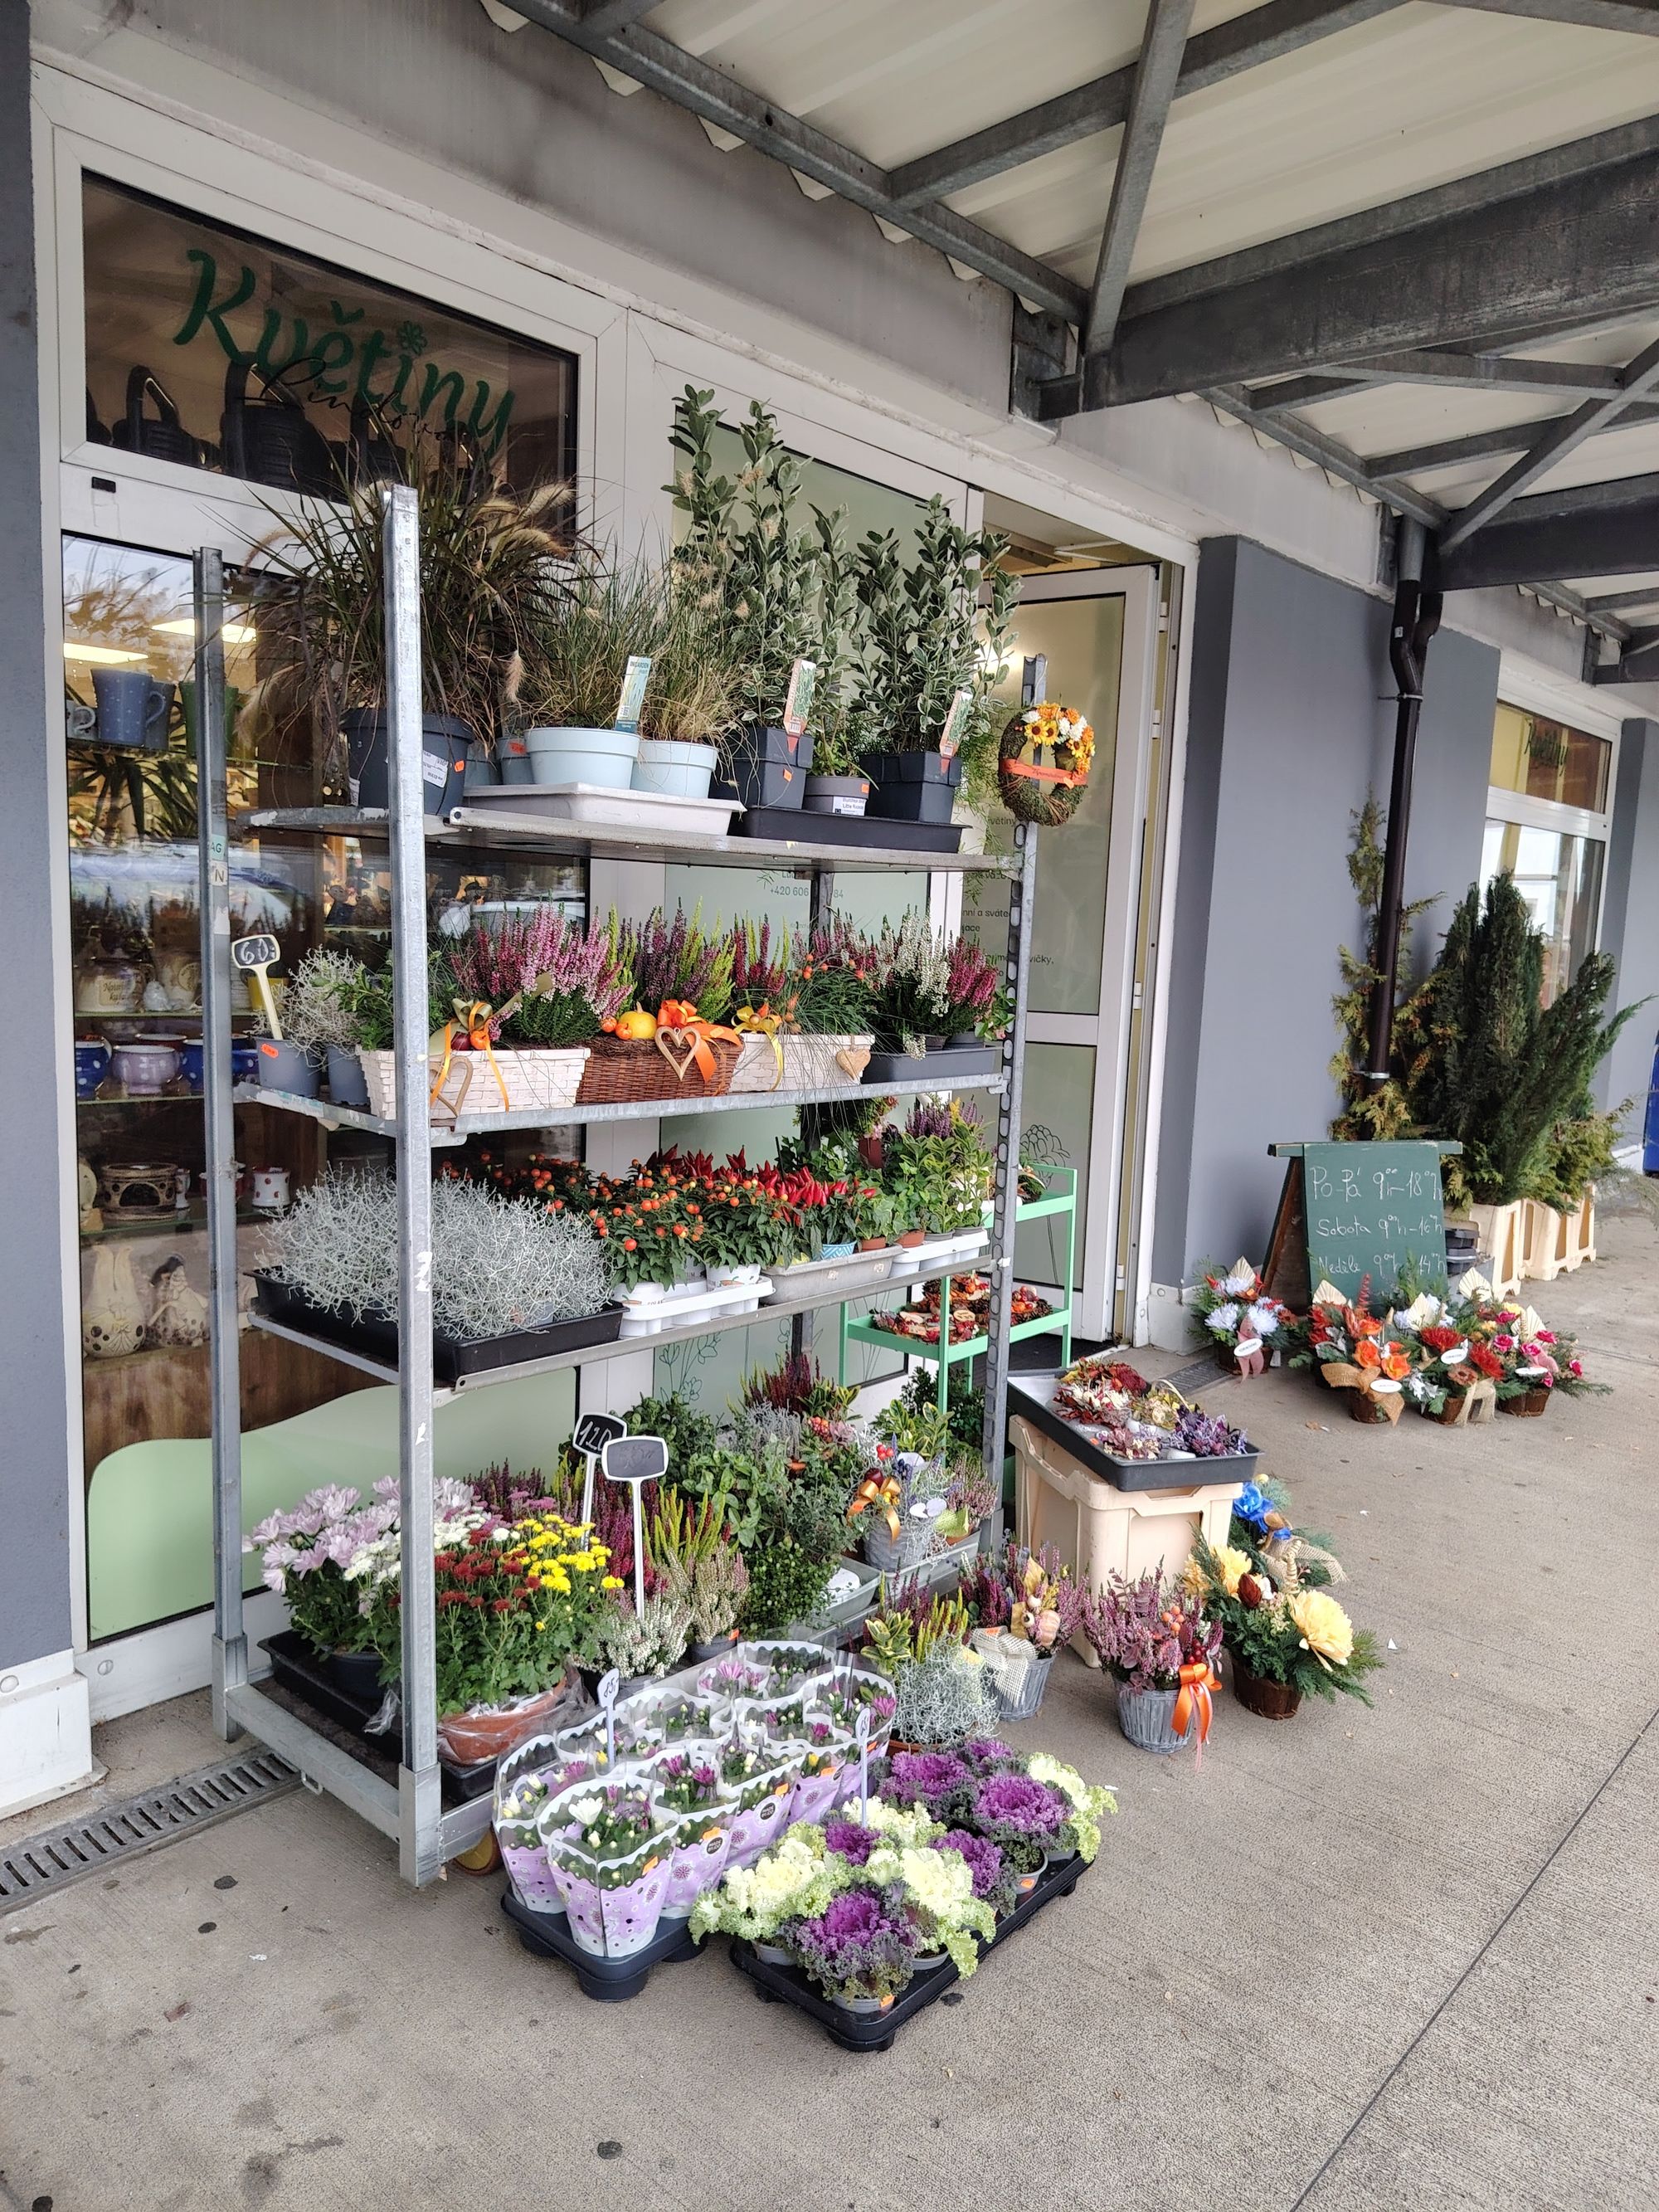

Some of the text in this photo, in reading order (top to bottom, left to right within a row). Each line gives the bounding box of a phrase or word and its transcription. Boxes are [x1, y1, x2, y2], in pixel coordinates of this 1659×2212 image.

[173, 249, 516, 458] Květiny
[988, 816, 1016, 827] větiny
[770, 885, 791, 896] +420
[792, 887, 810, 897] 606
[985, 909, 1010, 918] sváte
[1315, 1215, 1372, 1237] Sobota
